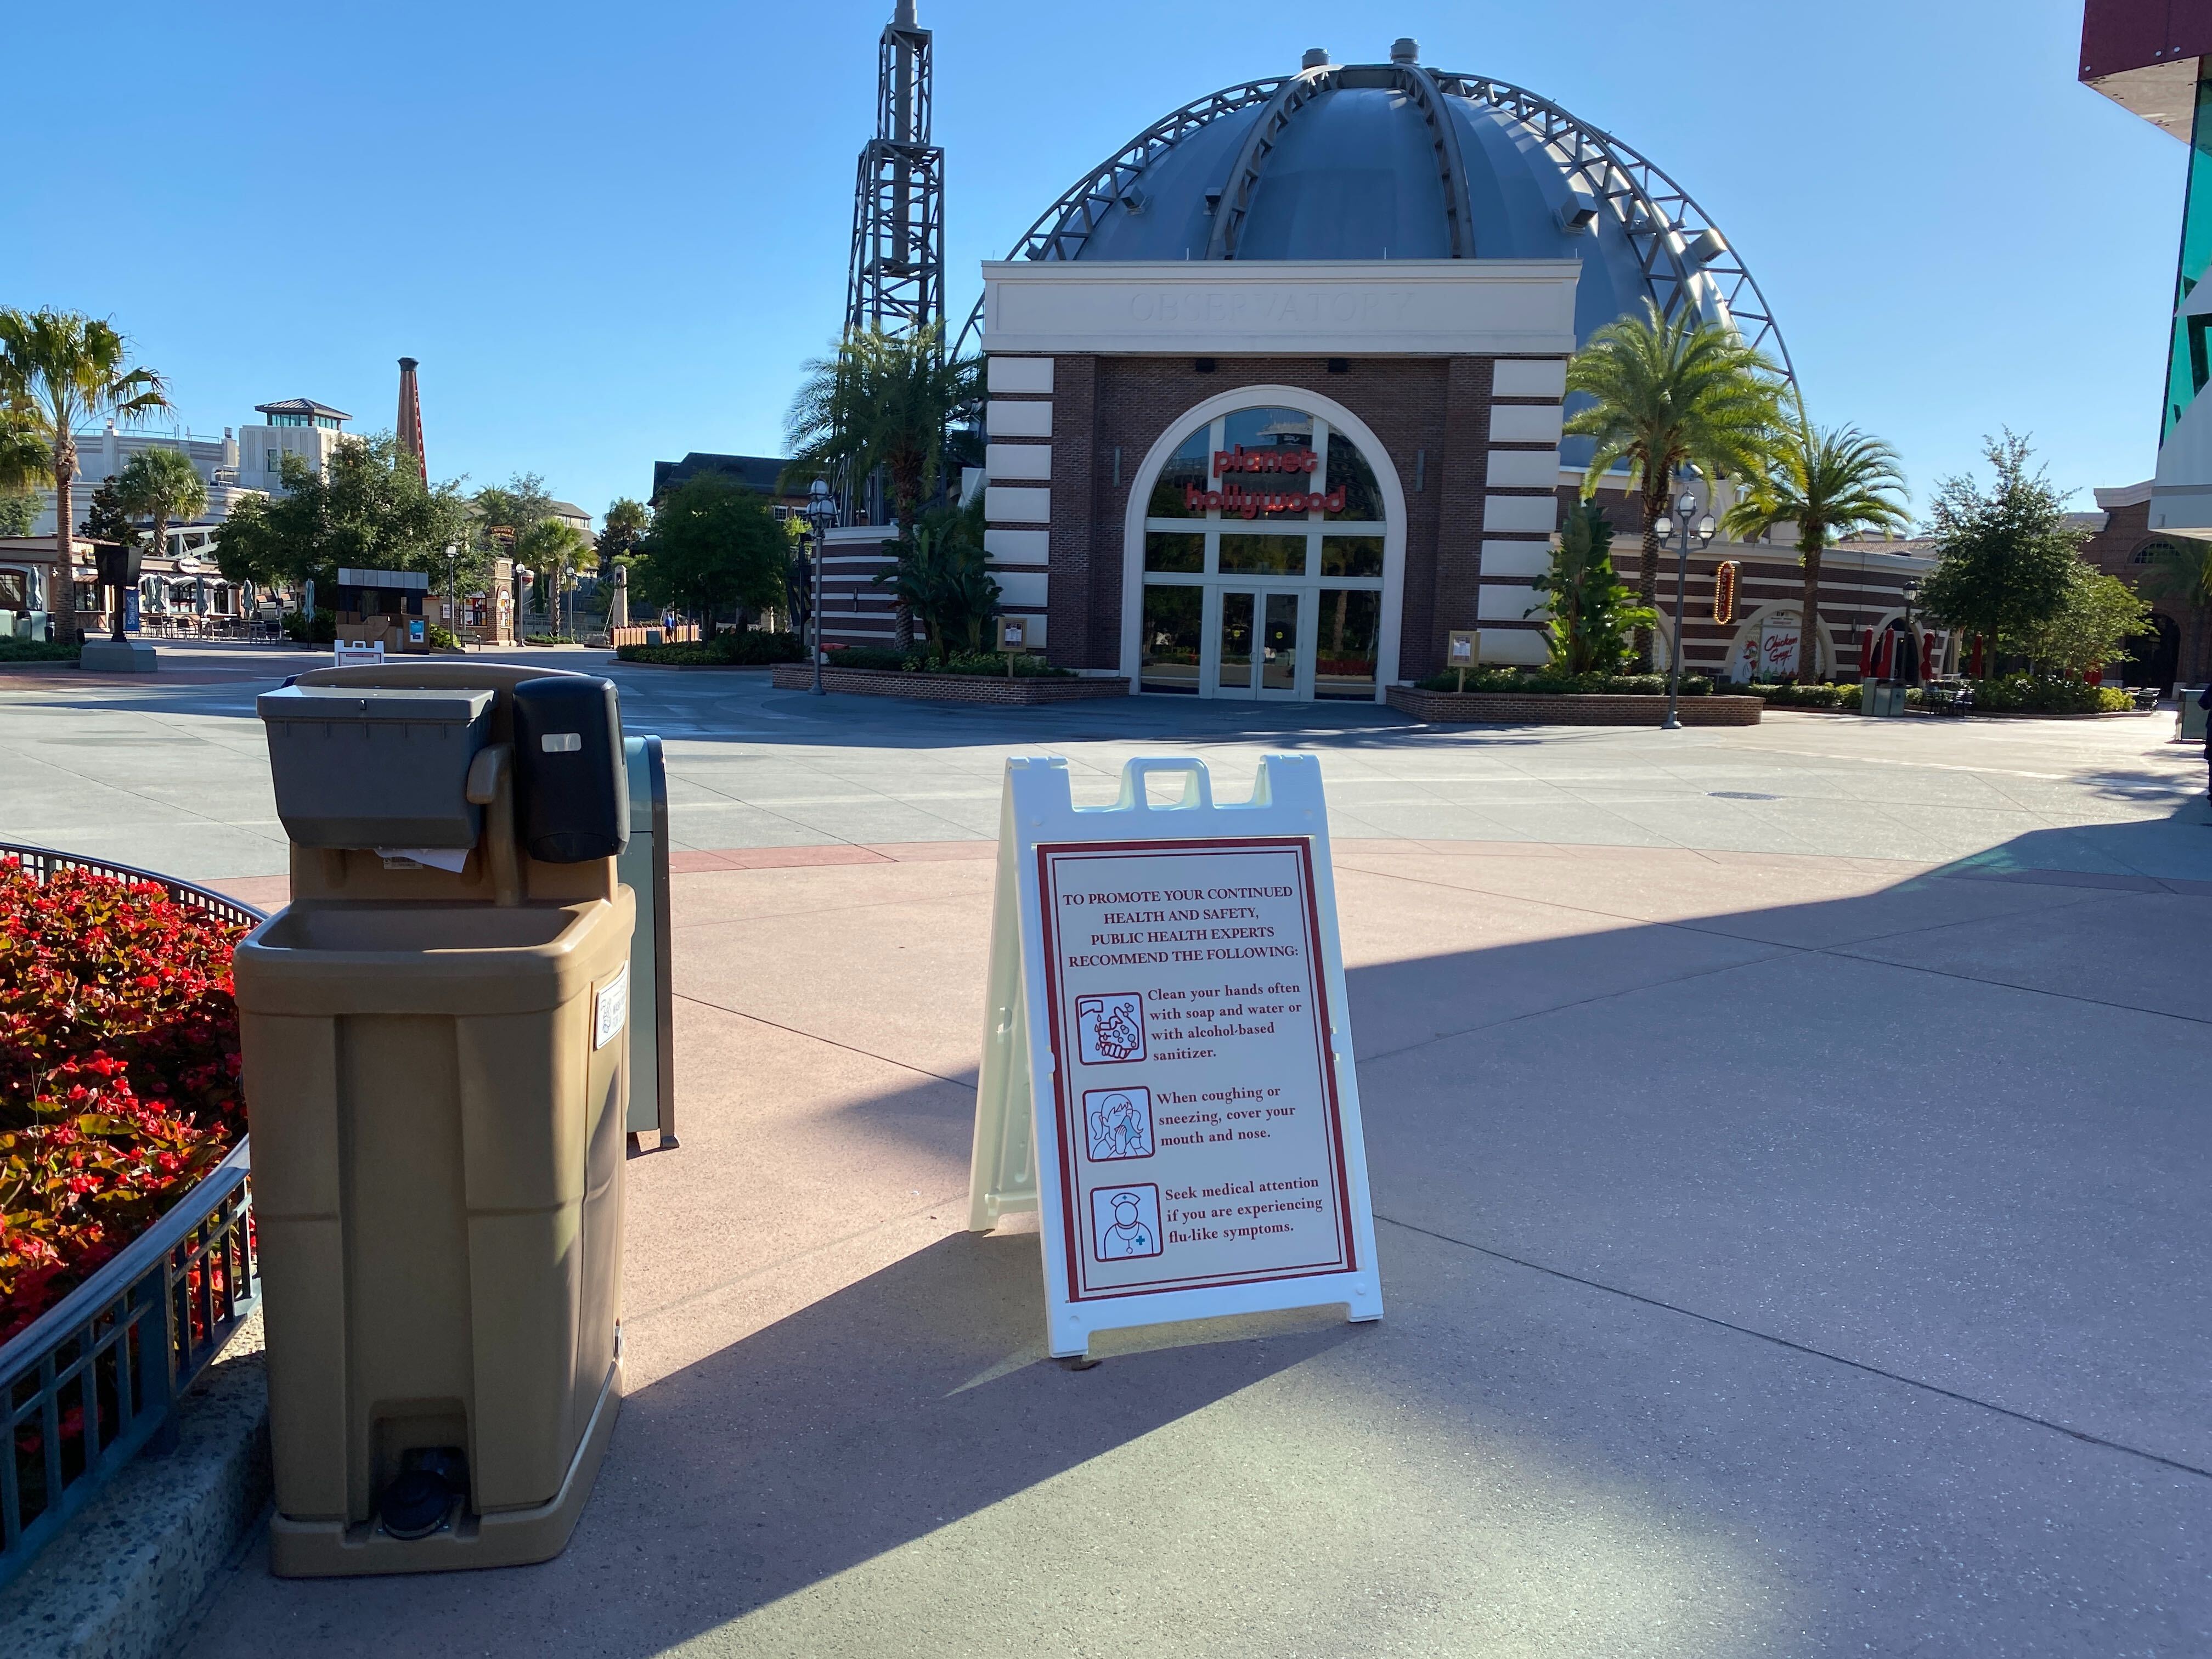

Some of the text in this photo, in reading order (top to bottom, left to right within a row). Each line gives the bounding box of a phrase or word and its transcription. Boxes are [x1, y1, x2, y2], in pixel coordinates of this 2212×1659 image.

[1130, 292, 1417, 321] OBSERVATORY
[1214, 444, 1318, 478] planet
[1186, 483, 1346, 519] hollywood
[127, 596, 135, 624] SPRINGS
[1764, 634, 1798, 651] Chicken
[1769, 646, 1793, 666] Guy!
[1062, 886, 1293, 906] TO PROMOTE YOUR CONTINUED
[1103, 907, 1259, 924] HEALTH AND SAFETY,
[1091, 926, 1274, 946] PUBLIC HEALTH EXPERTS
[1068, 945, 1299, 968] RECOMMEND THE FOLLOWING:
[1148, 982, 1301, 1002] Clean your hands often
[1149, 1003, 1302, 1022] with soap and water or
[1150, 1021, 1275, 1041] with alcohol-based
[1153, 1047, 1216, 1061] sanitizer.
[1156, 1087, 1281, 1105] When coughing or
[1158, 1107, 1296, 1126] sneezing, cover your
[1160, 1128, 1271, 1147] mouth and nose.
[1165, 1176, 1319, 1201] Seek medical attention
[1166, 1197, 1323, 1225] if you are experiencing
[1168, 1223, 1294, 1244] flu-like symptoms.
